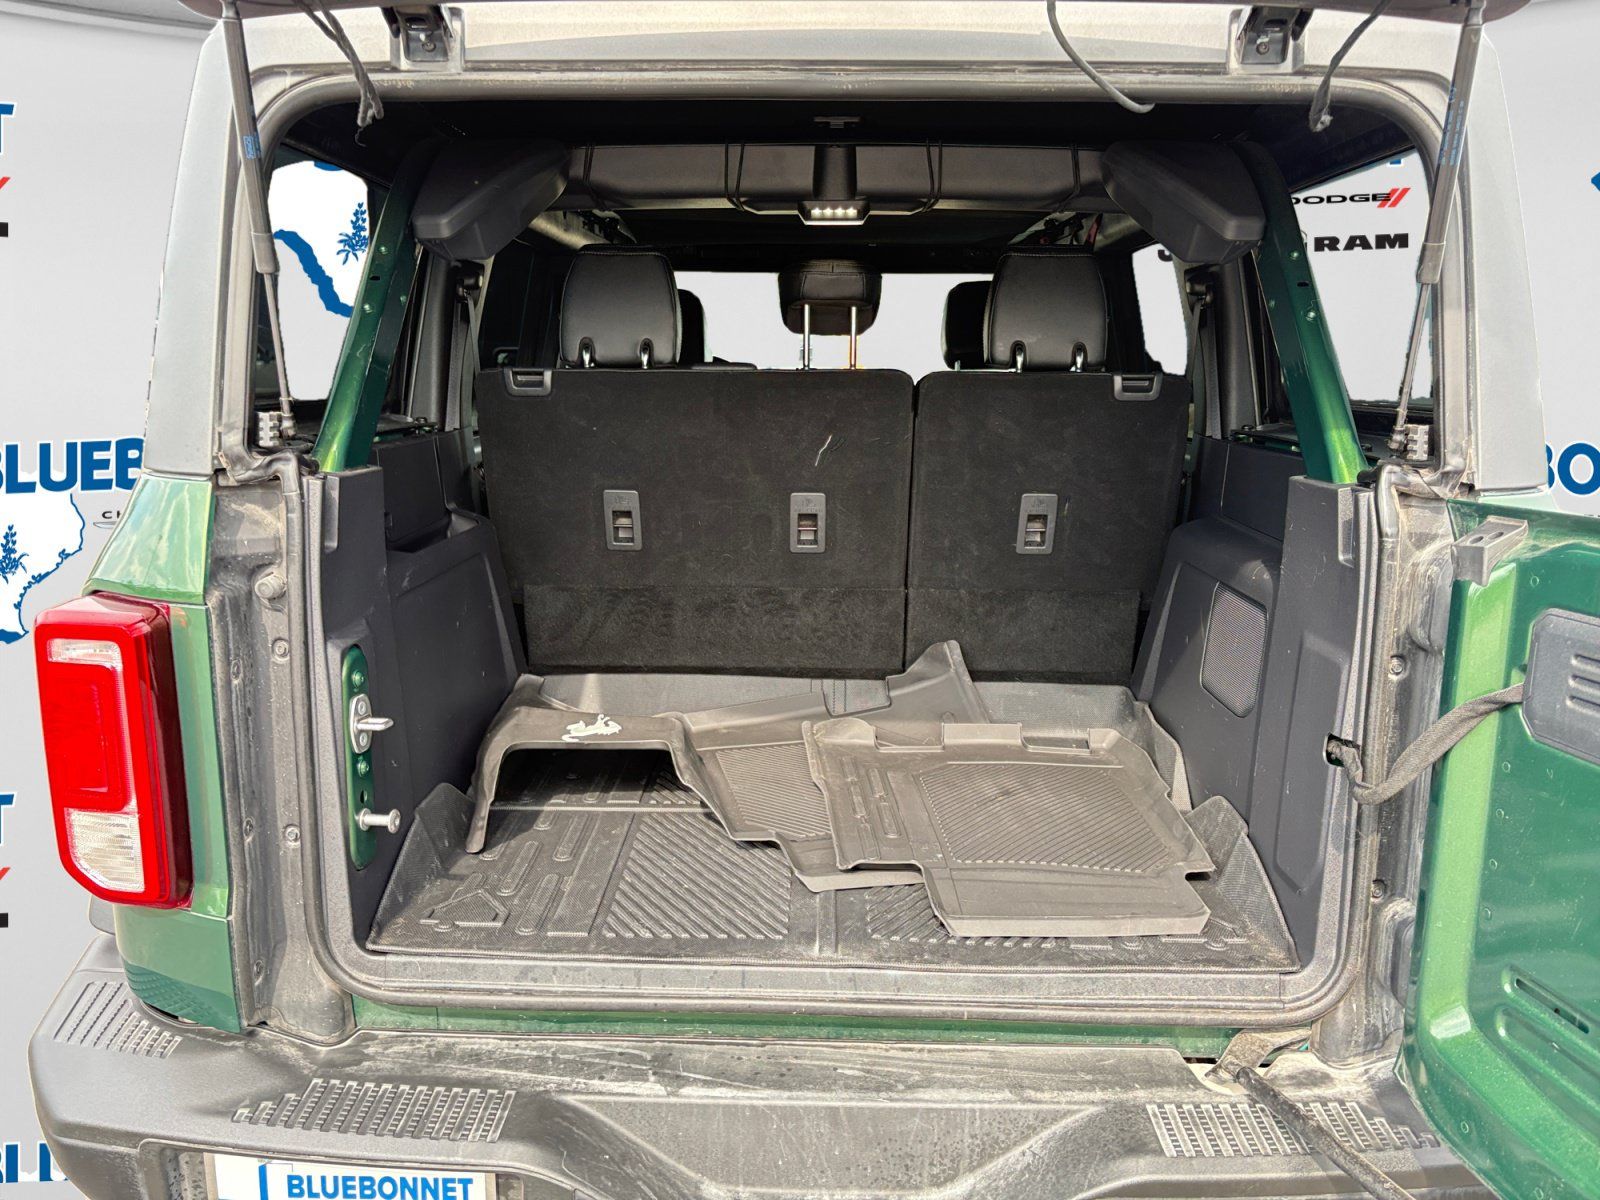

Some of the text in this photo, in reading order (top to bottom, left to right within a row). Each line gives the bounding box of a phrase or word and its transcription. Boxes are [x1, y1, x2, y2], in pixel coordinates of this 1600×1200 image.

[1313, 232, 1409, 252] RAM
[0, 437, 145, 494] LUEB
[286, 1174, 474, 1200] BLUEBONNET
